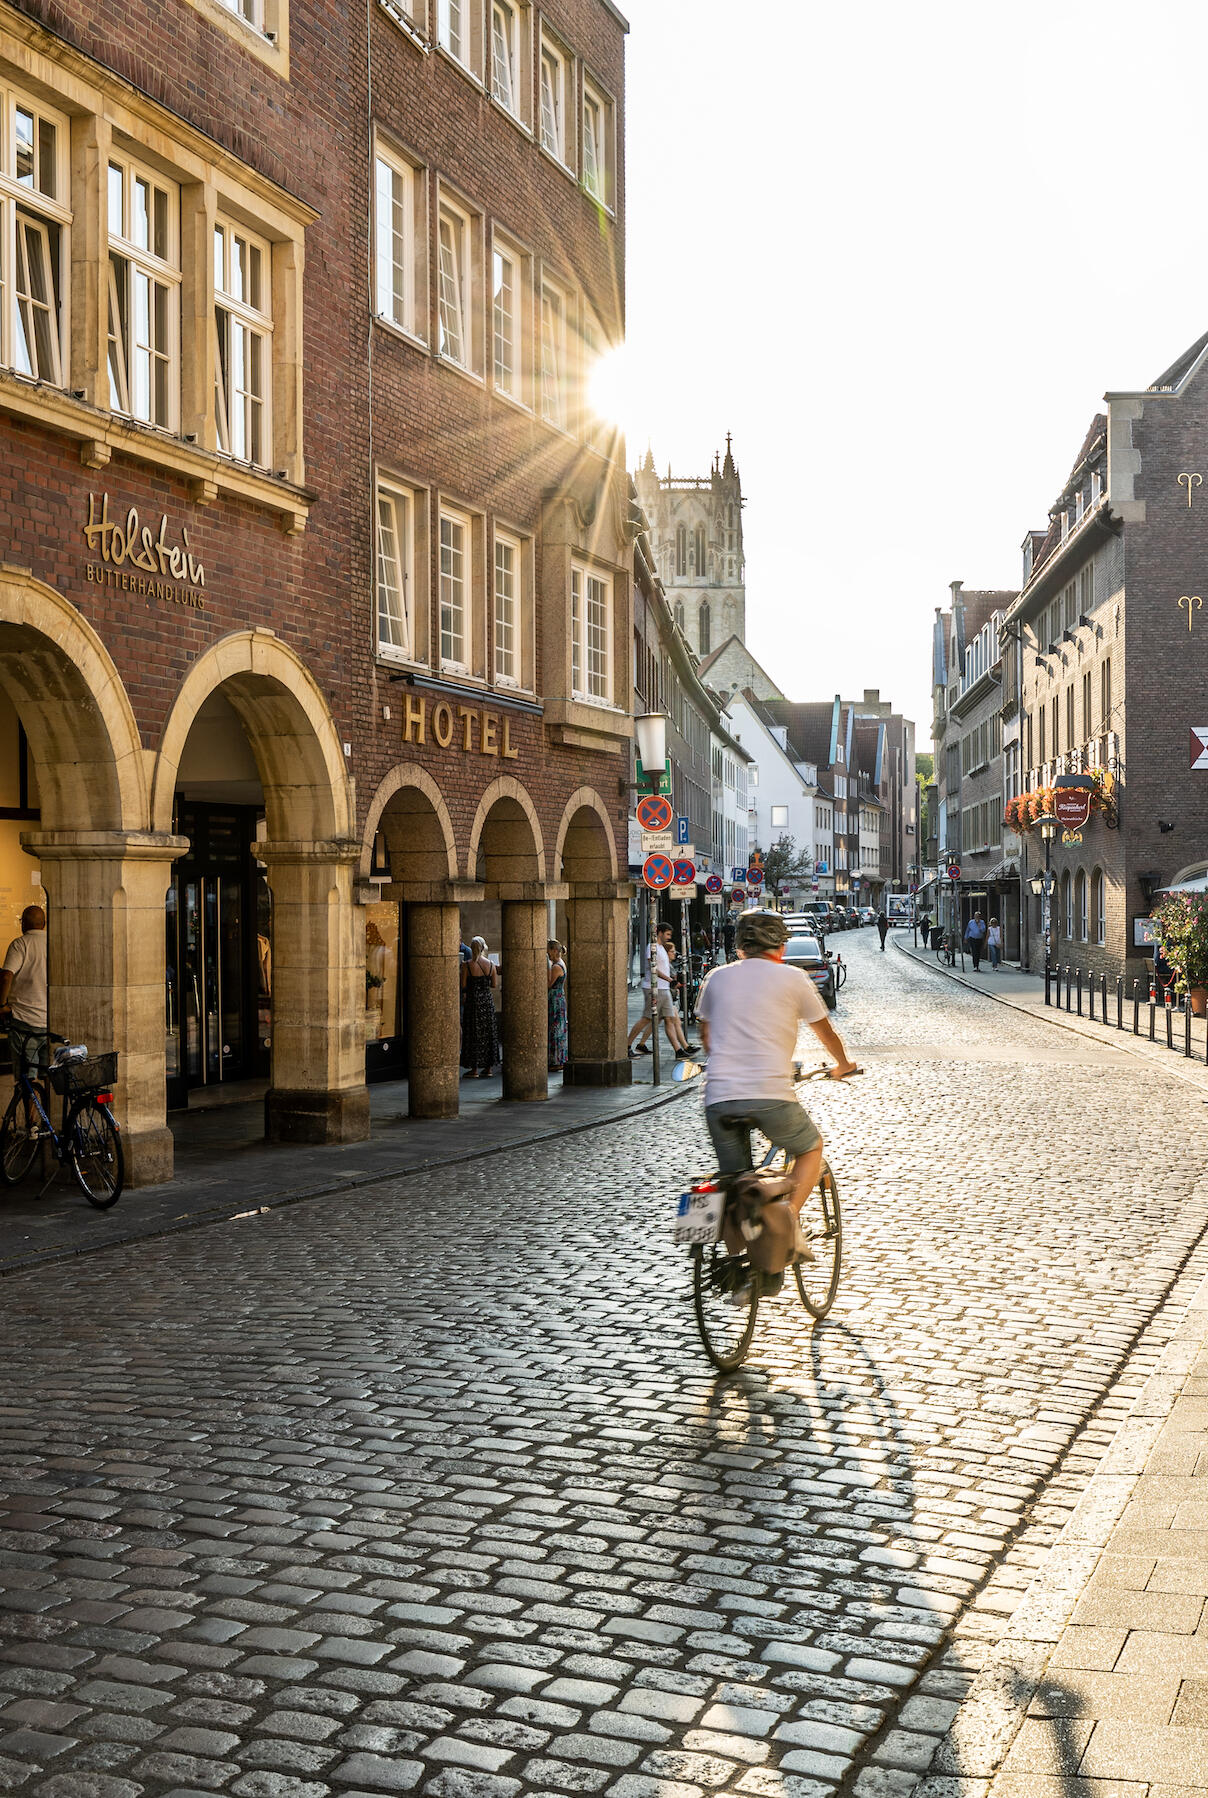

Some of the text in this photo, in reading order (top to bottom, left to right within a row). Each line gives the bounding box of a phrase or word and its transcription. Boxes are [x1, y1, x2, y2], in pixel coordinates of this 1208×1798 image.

[83, 492, 205, 586] Holstein
[86, 563, 205, 609] BUTTERHANDLUNG
[402, 692, 519, 759] HOTEL
[679, 820, 687, 841] P
[734, 869, 743, 880] P
